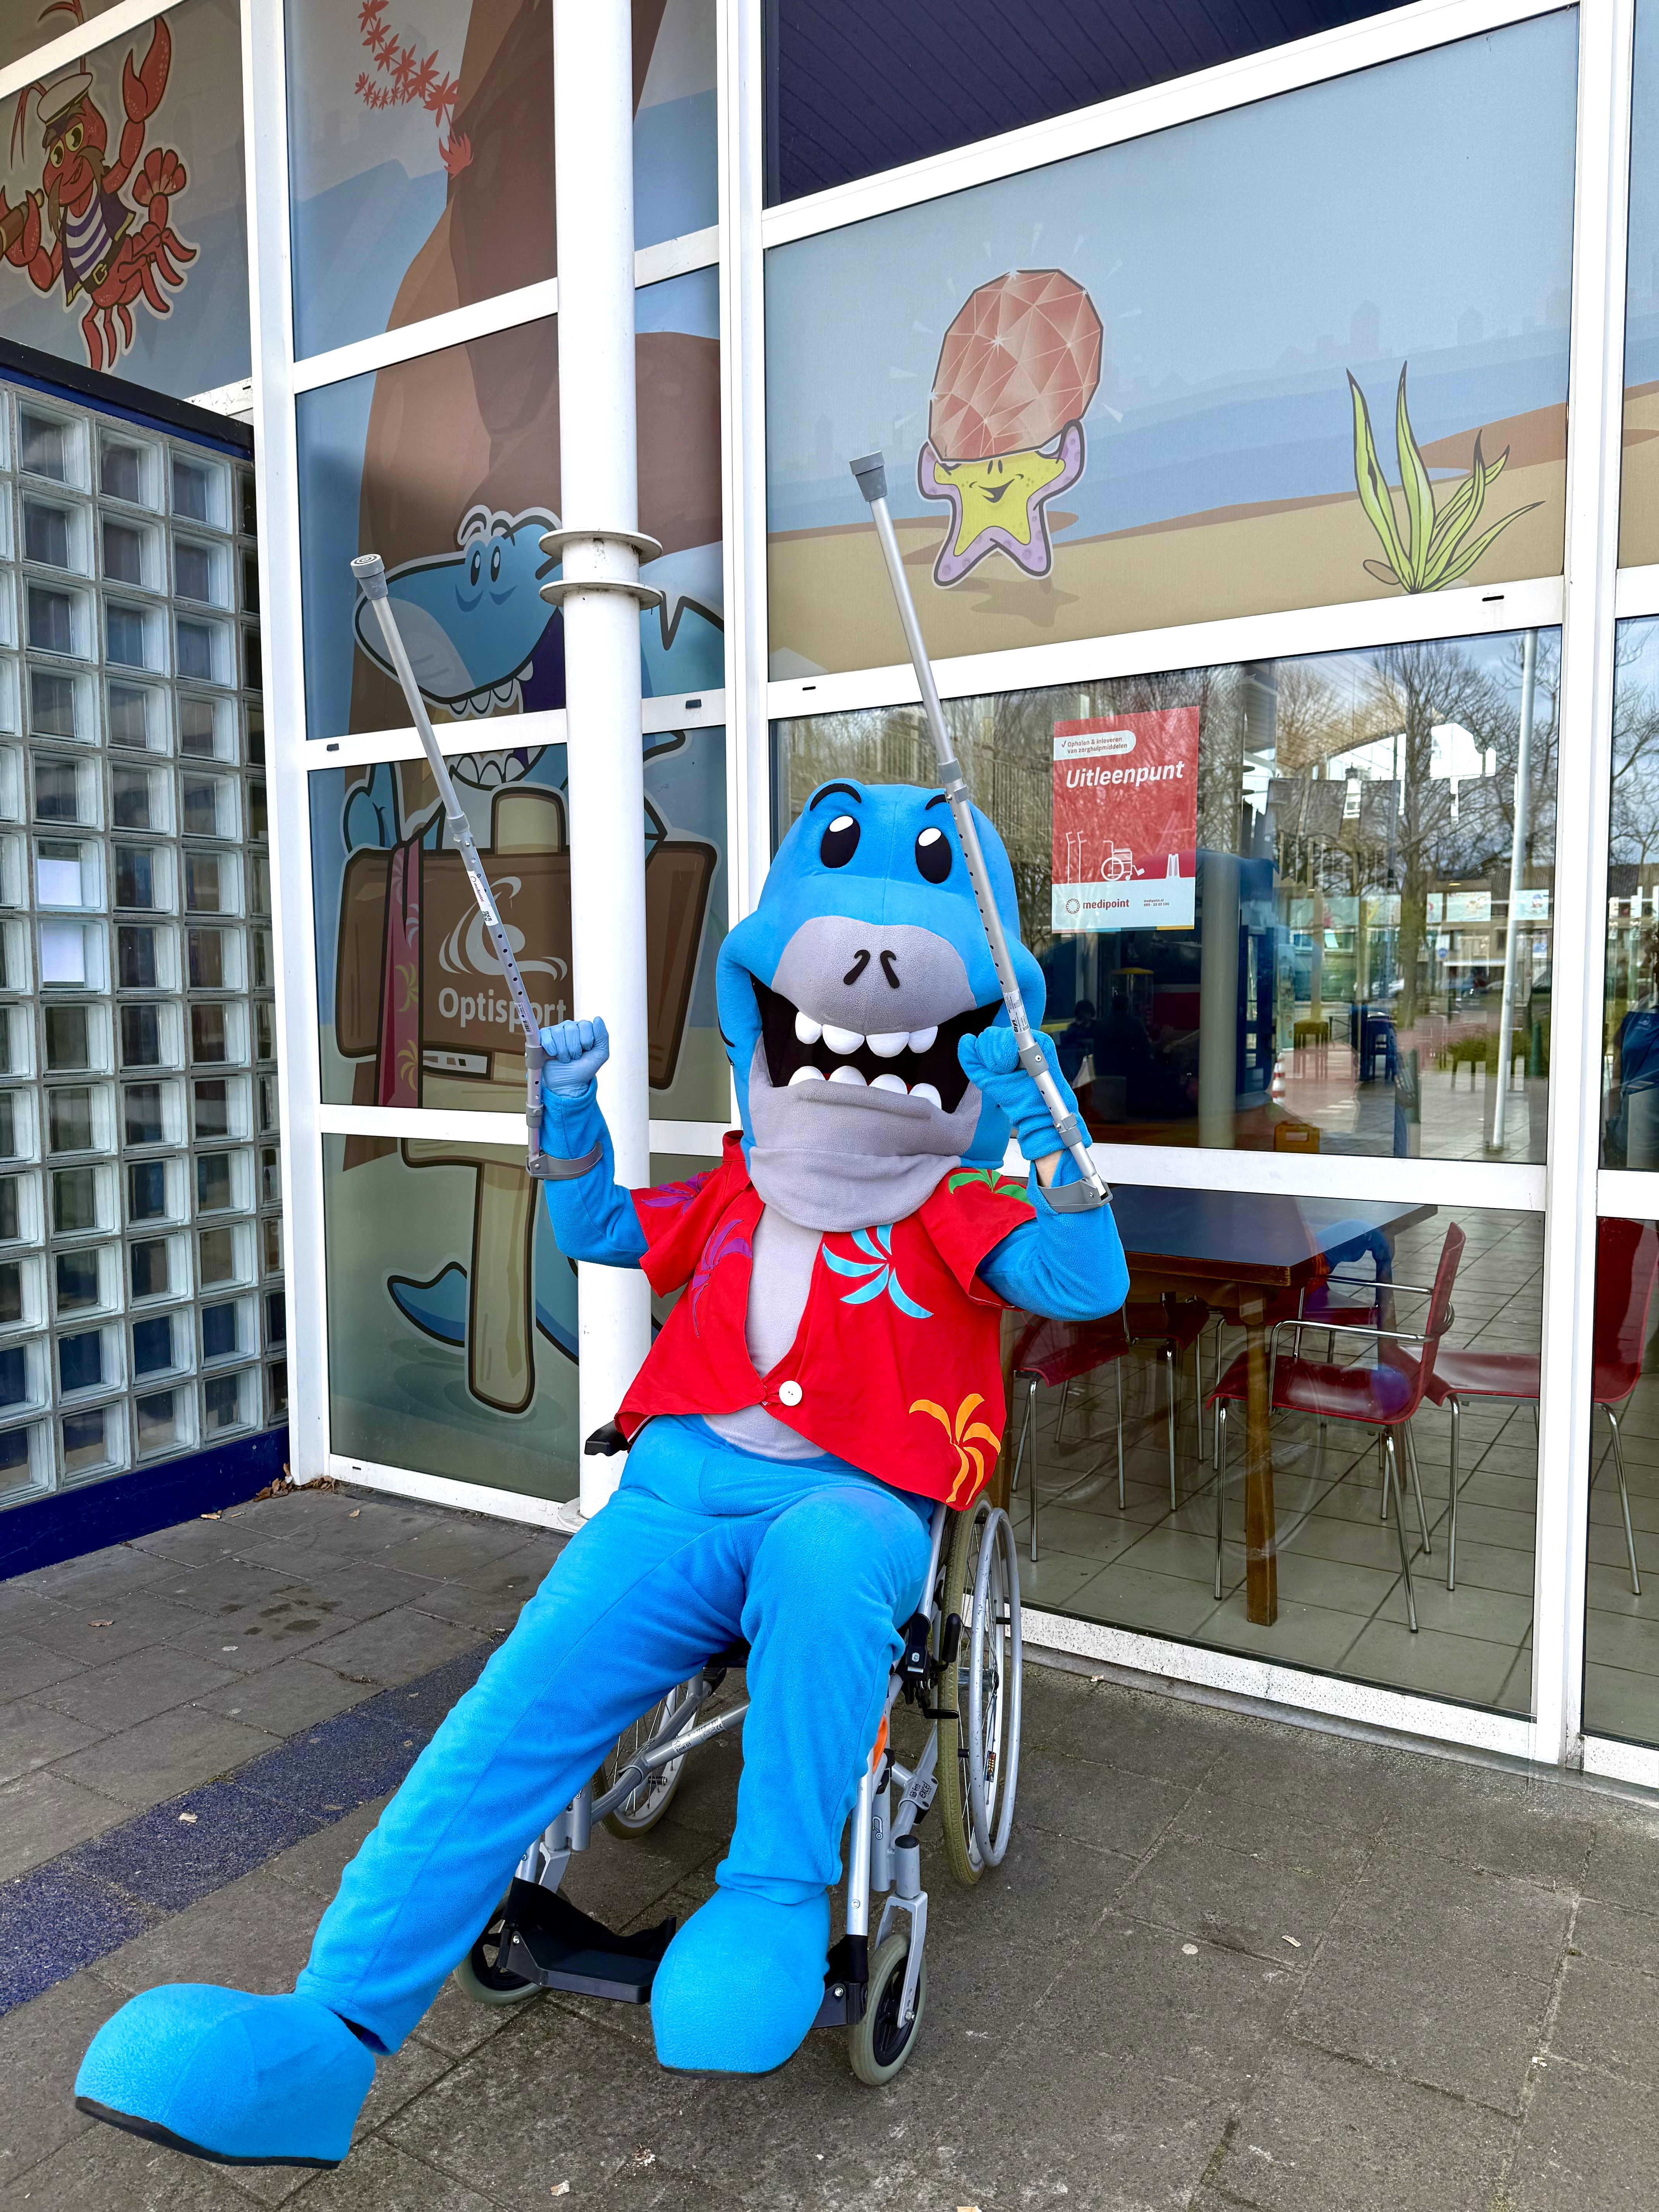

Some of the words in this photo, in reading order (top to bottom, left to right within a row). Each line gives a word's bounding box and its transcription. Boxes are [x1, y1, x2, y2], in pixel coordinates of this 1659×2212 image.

[1079, 743, 1128, 753] zorghulpmiddelen
[1066, 761, 1185, 788] Uitleenpunt
[1083, 898, 1129, 910] medipoint
[438, 987, 567, 1033] Optisport
